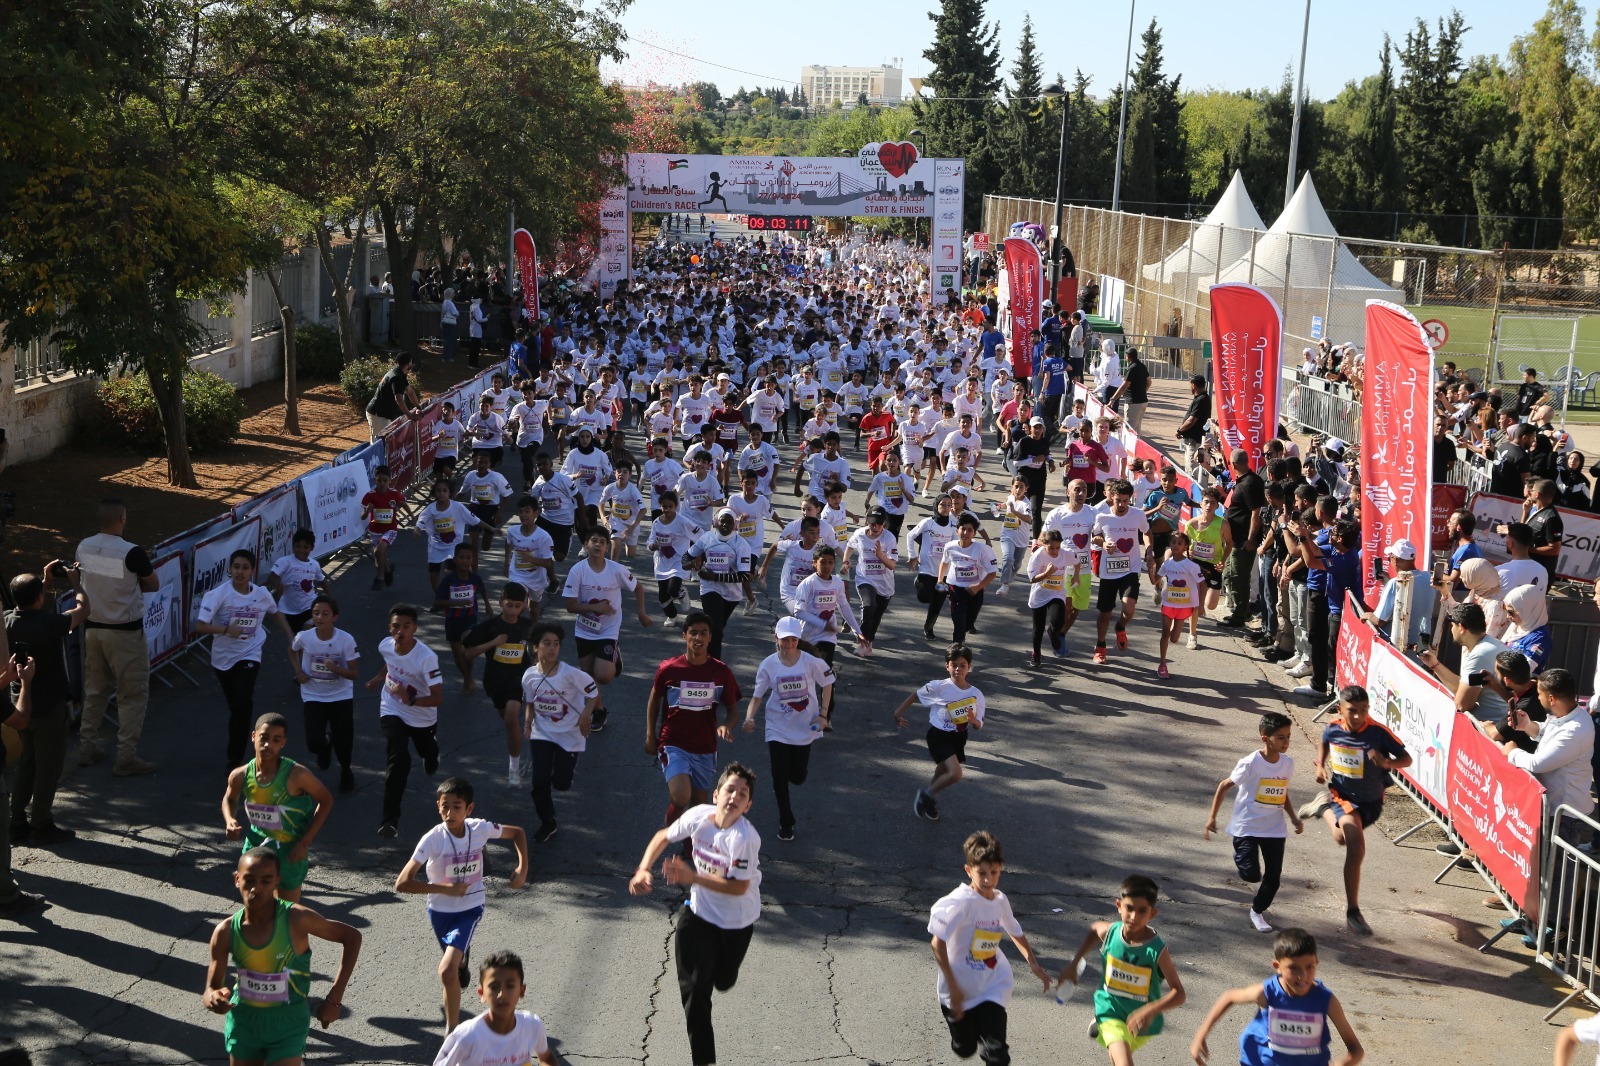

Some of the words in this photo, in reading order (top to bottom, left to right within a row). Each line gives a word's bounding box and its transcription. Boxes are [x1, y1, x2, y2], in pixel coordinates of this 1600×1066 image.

[758, 192, 801, 200] 27/9/2024
[630, 200, 672, 210] Children's
[674, 201, 697, 210] RACE
[864, 205, 889, 214] START
[890, 206, 897, 214] &
[899, 205, 925, 214] FINISH
[1431, 506, 1449, 514] بروم
[1430, 525, 1446, 534] برو
[1562, 533, 1600, 553] zai
[1106, 560, 1130, 570] 11929
[687, 690, 708, 698] 9459
[1405, 698, 1427, 731] RUN
[1456, 748, 1484, 777] AMMAN
[1455, 759, 1482, 788] MARATHON
[1265, 787, 1285, 795] 9012
[249, 811, 273, 820] 9532
[453, 864, 478, 875] 9447
[1111, 969, 1140, 984] 8997
[247, 979, 278, 991] 9533
[1279, 1023, 1313, 1035] 9453
